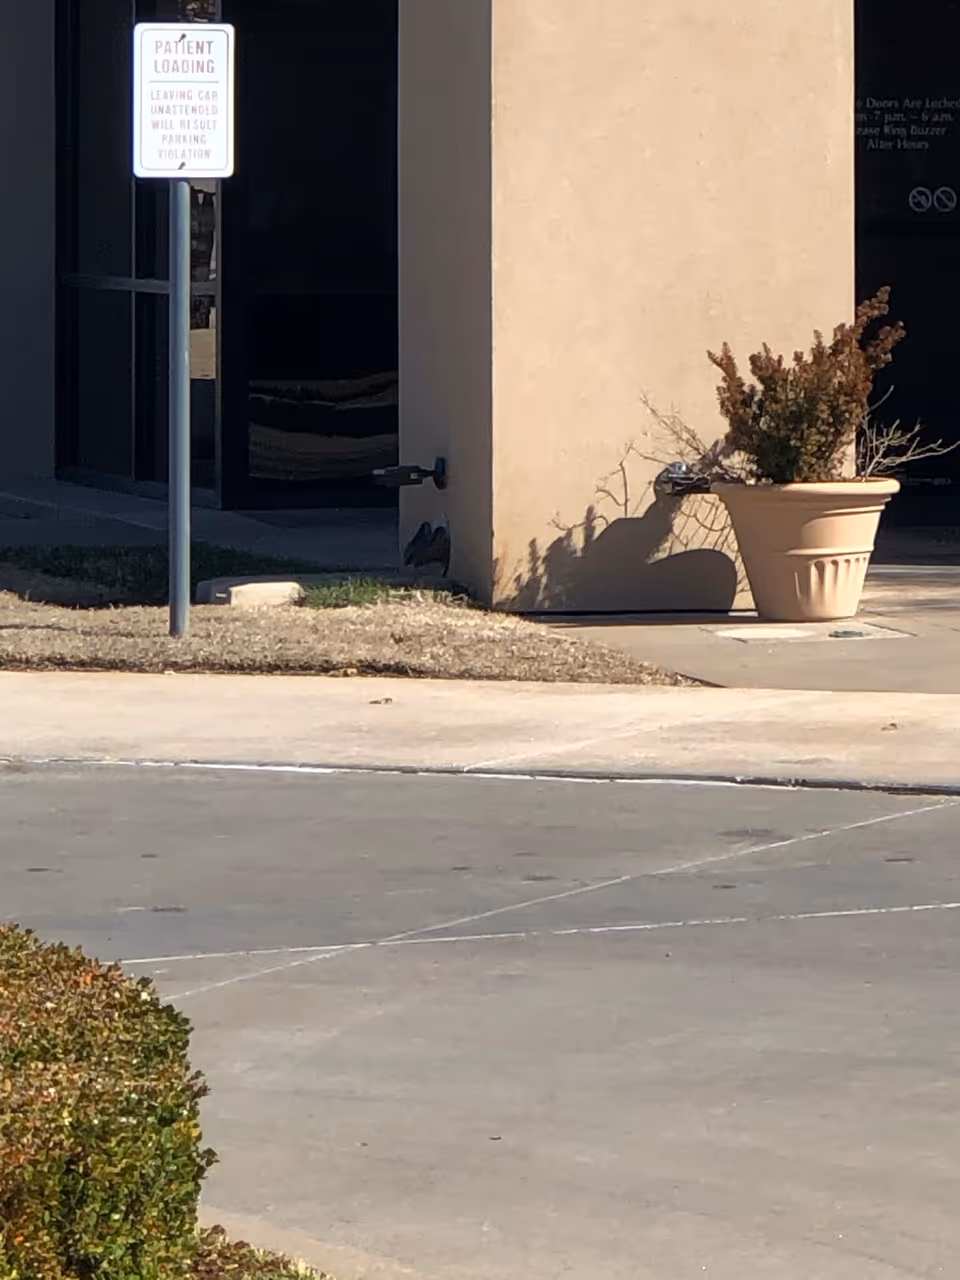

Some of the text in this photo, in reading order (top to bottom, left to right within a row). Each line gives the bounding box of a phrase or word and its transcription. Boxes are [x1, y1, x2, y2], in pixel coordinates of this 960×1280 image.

[154, 40, 214, 55] PATIENT
[154, 59, 215, 74] LOADING
[150, 90, 218, 101] LEAVING CAR
[866, 98, 899, 109] Doors
[902, 98, 923, 109] Are
[150, 104, 219, 116] UNATTENDED
[151, 119, 217, 130] WILL RESULT
[856, 126, 880, 136] ease
[162, 134, 207, 145] PARKING
[158, 148, 212, 160] VIOLATION
